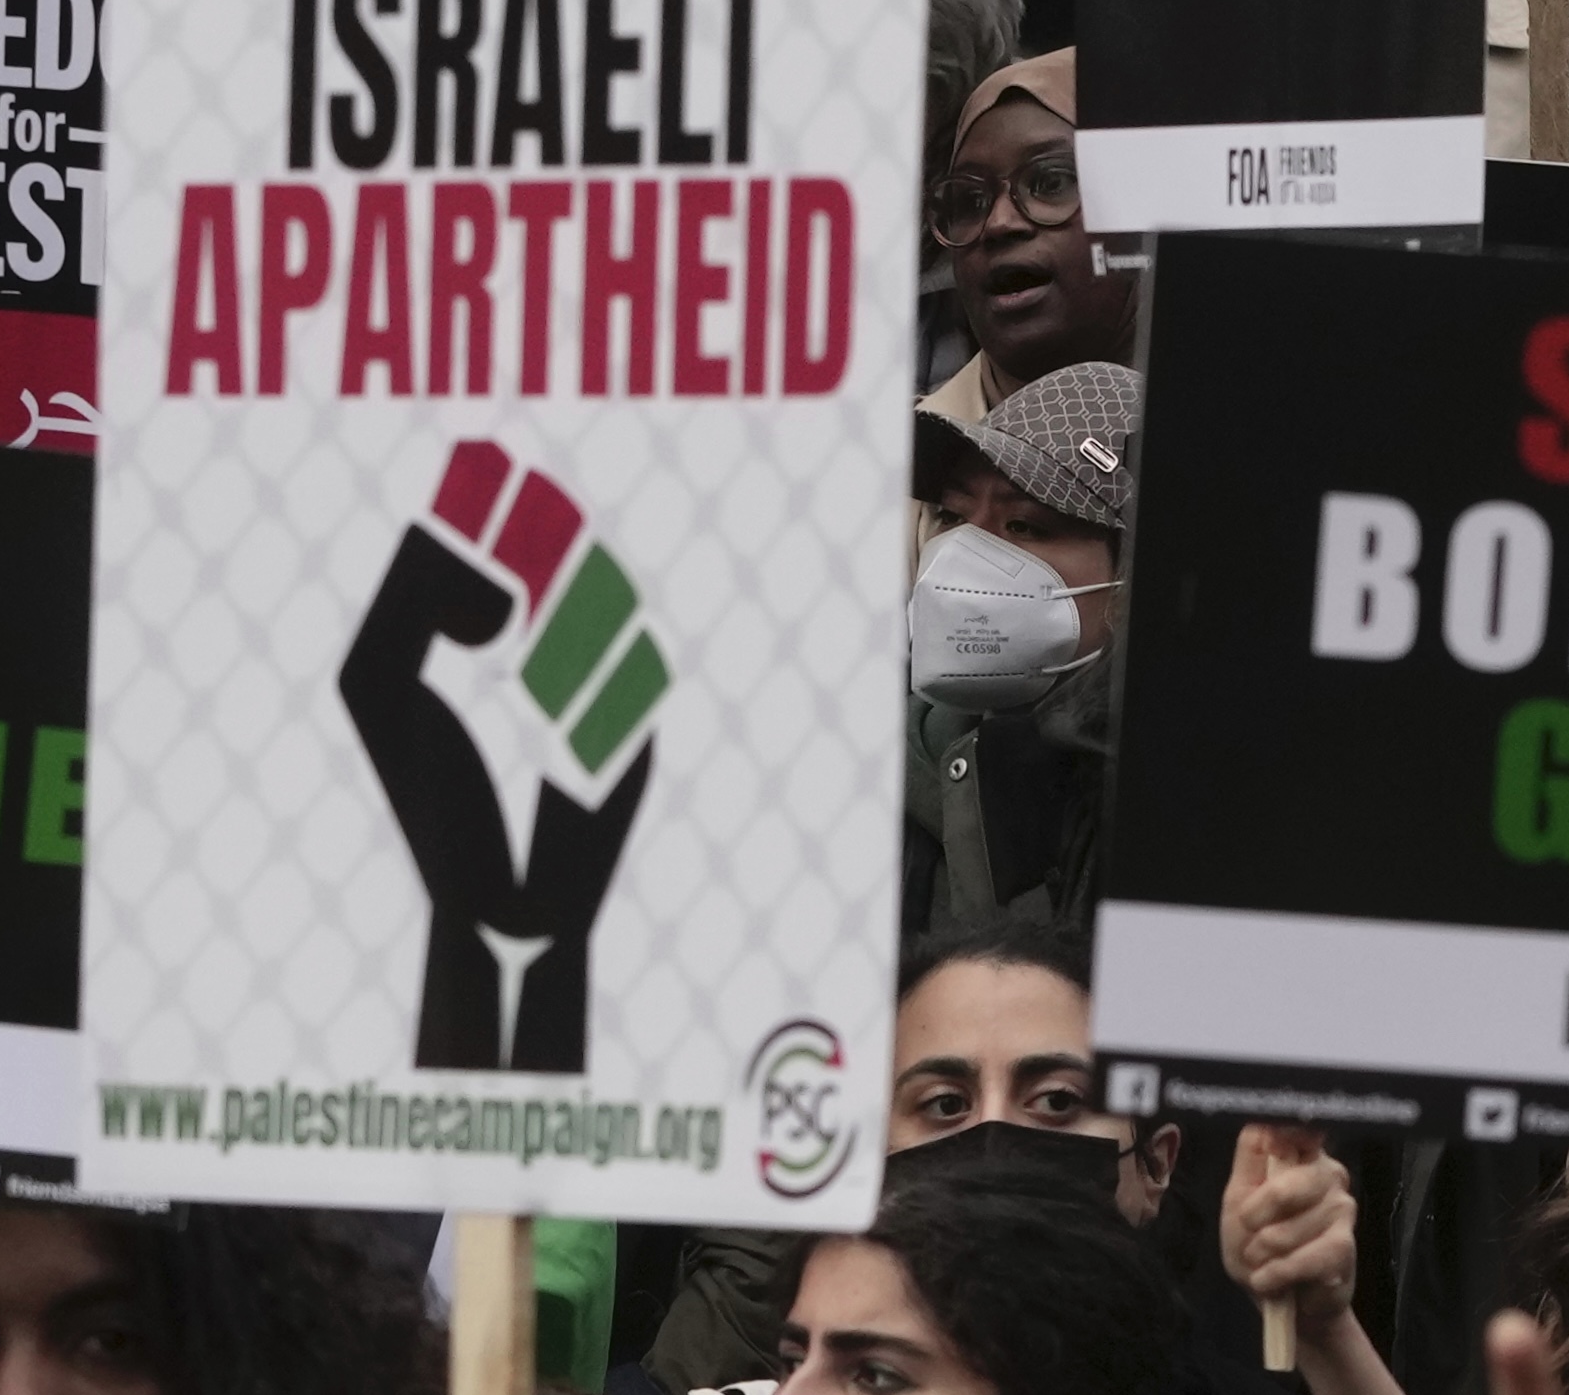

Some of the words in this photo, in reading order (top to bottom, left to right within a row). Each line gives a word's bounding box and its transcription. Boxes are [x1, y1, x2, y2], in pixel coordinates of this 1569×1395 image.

[1227, 147, 1270, 208] FOA
[164, 176, 856, 399] APARTHEID
[97, 1078, 724, 1171] www.palestinecampaign.org
[763, 1078, 838, 1142] PSC
